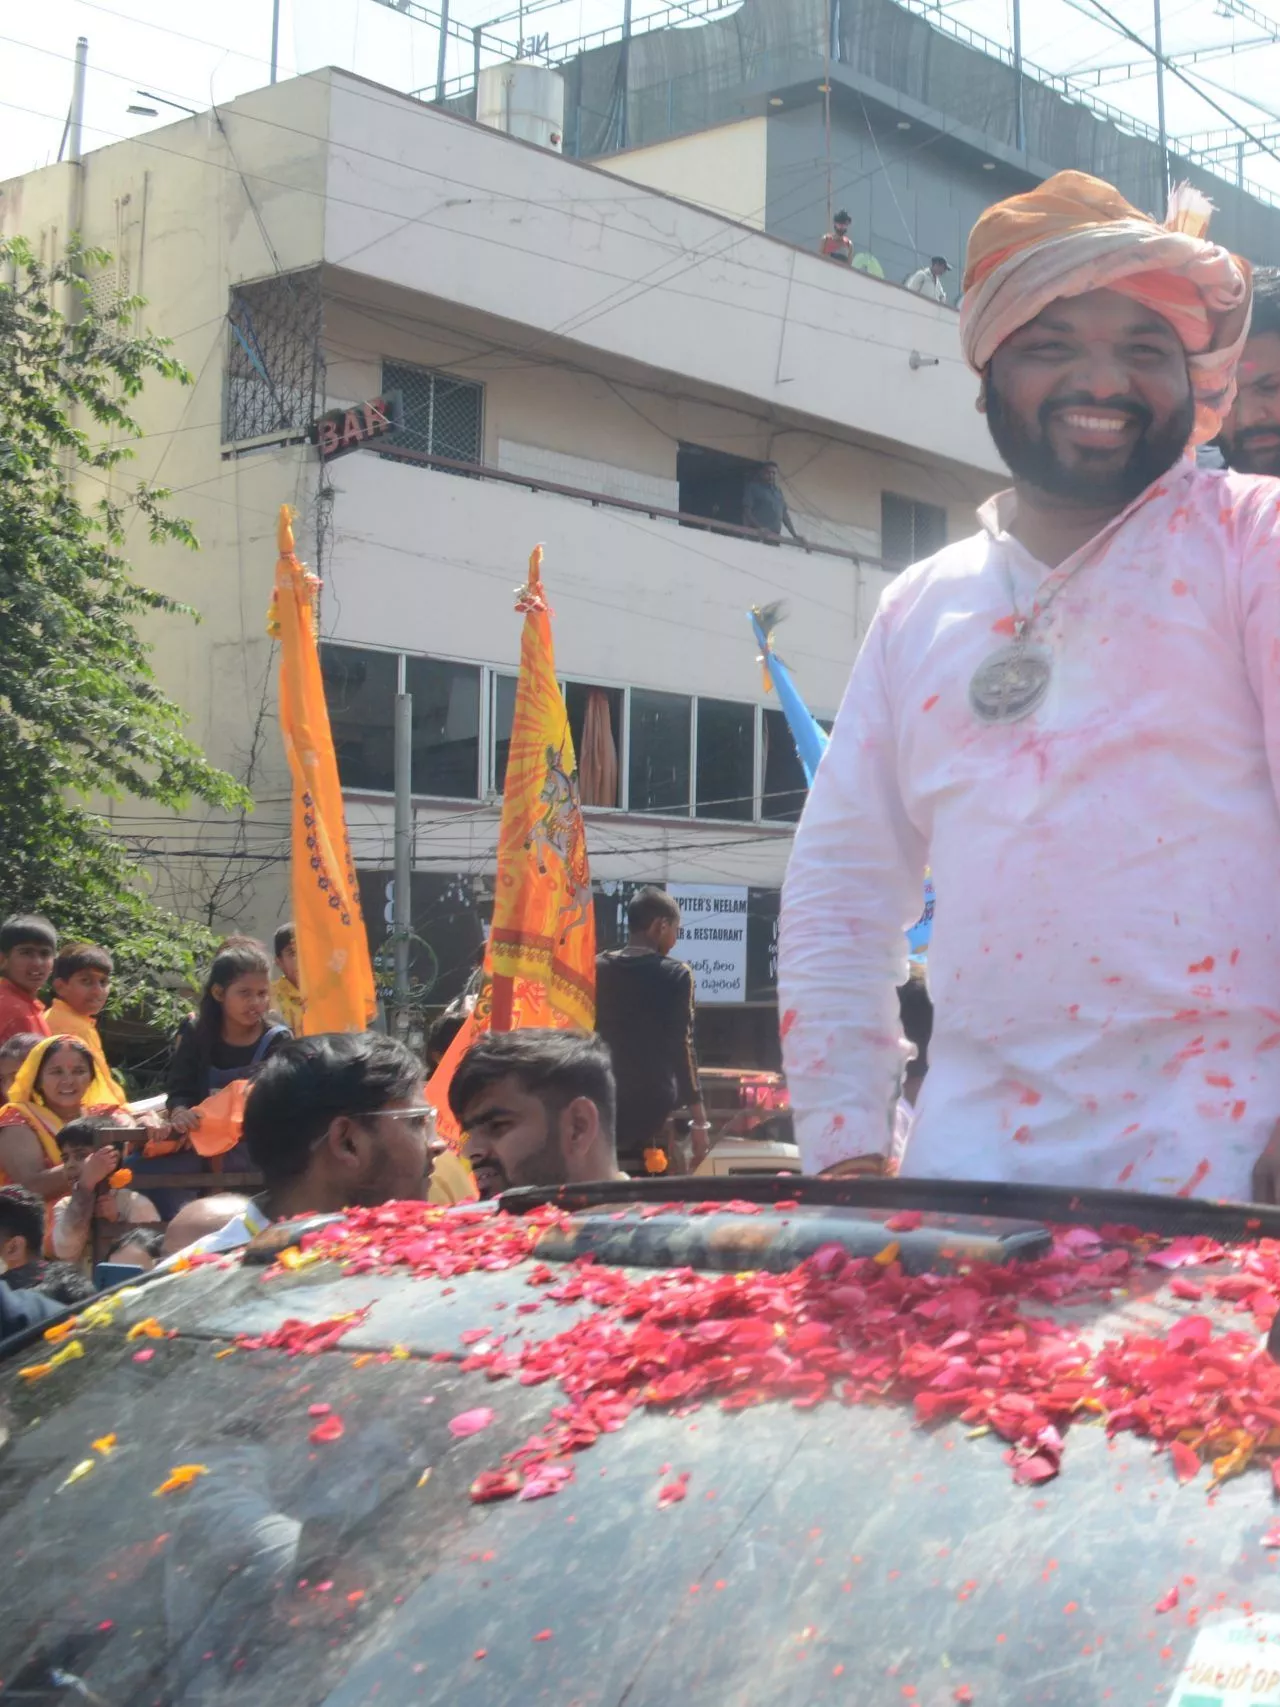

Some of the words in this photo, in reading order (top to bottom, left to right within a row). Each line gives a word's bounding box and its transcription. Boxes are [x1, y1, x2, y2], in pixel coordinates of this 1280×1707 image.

[319, 396, 388, 455] BAR
[713, 898, 747, 914] NEELAM
[686, 929, 693, 941] &
[694, 928, 743, 941] RESTAURANT
[1189, 1660, 1248, 1690] VALID
